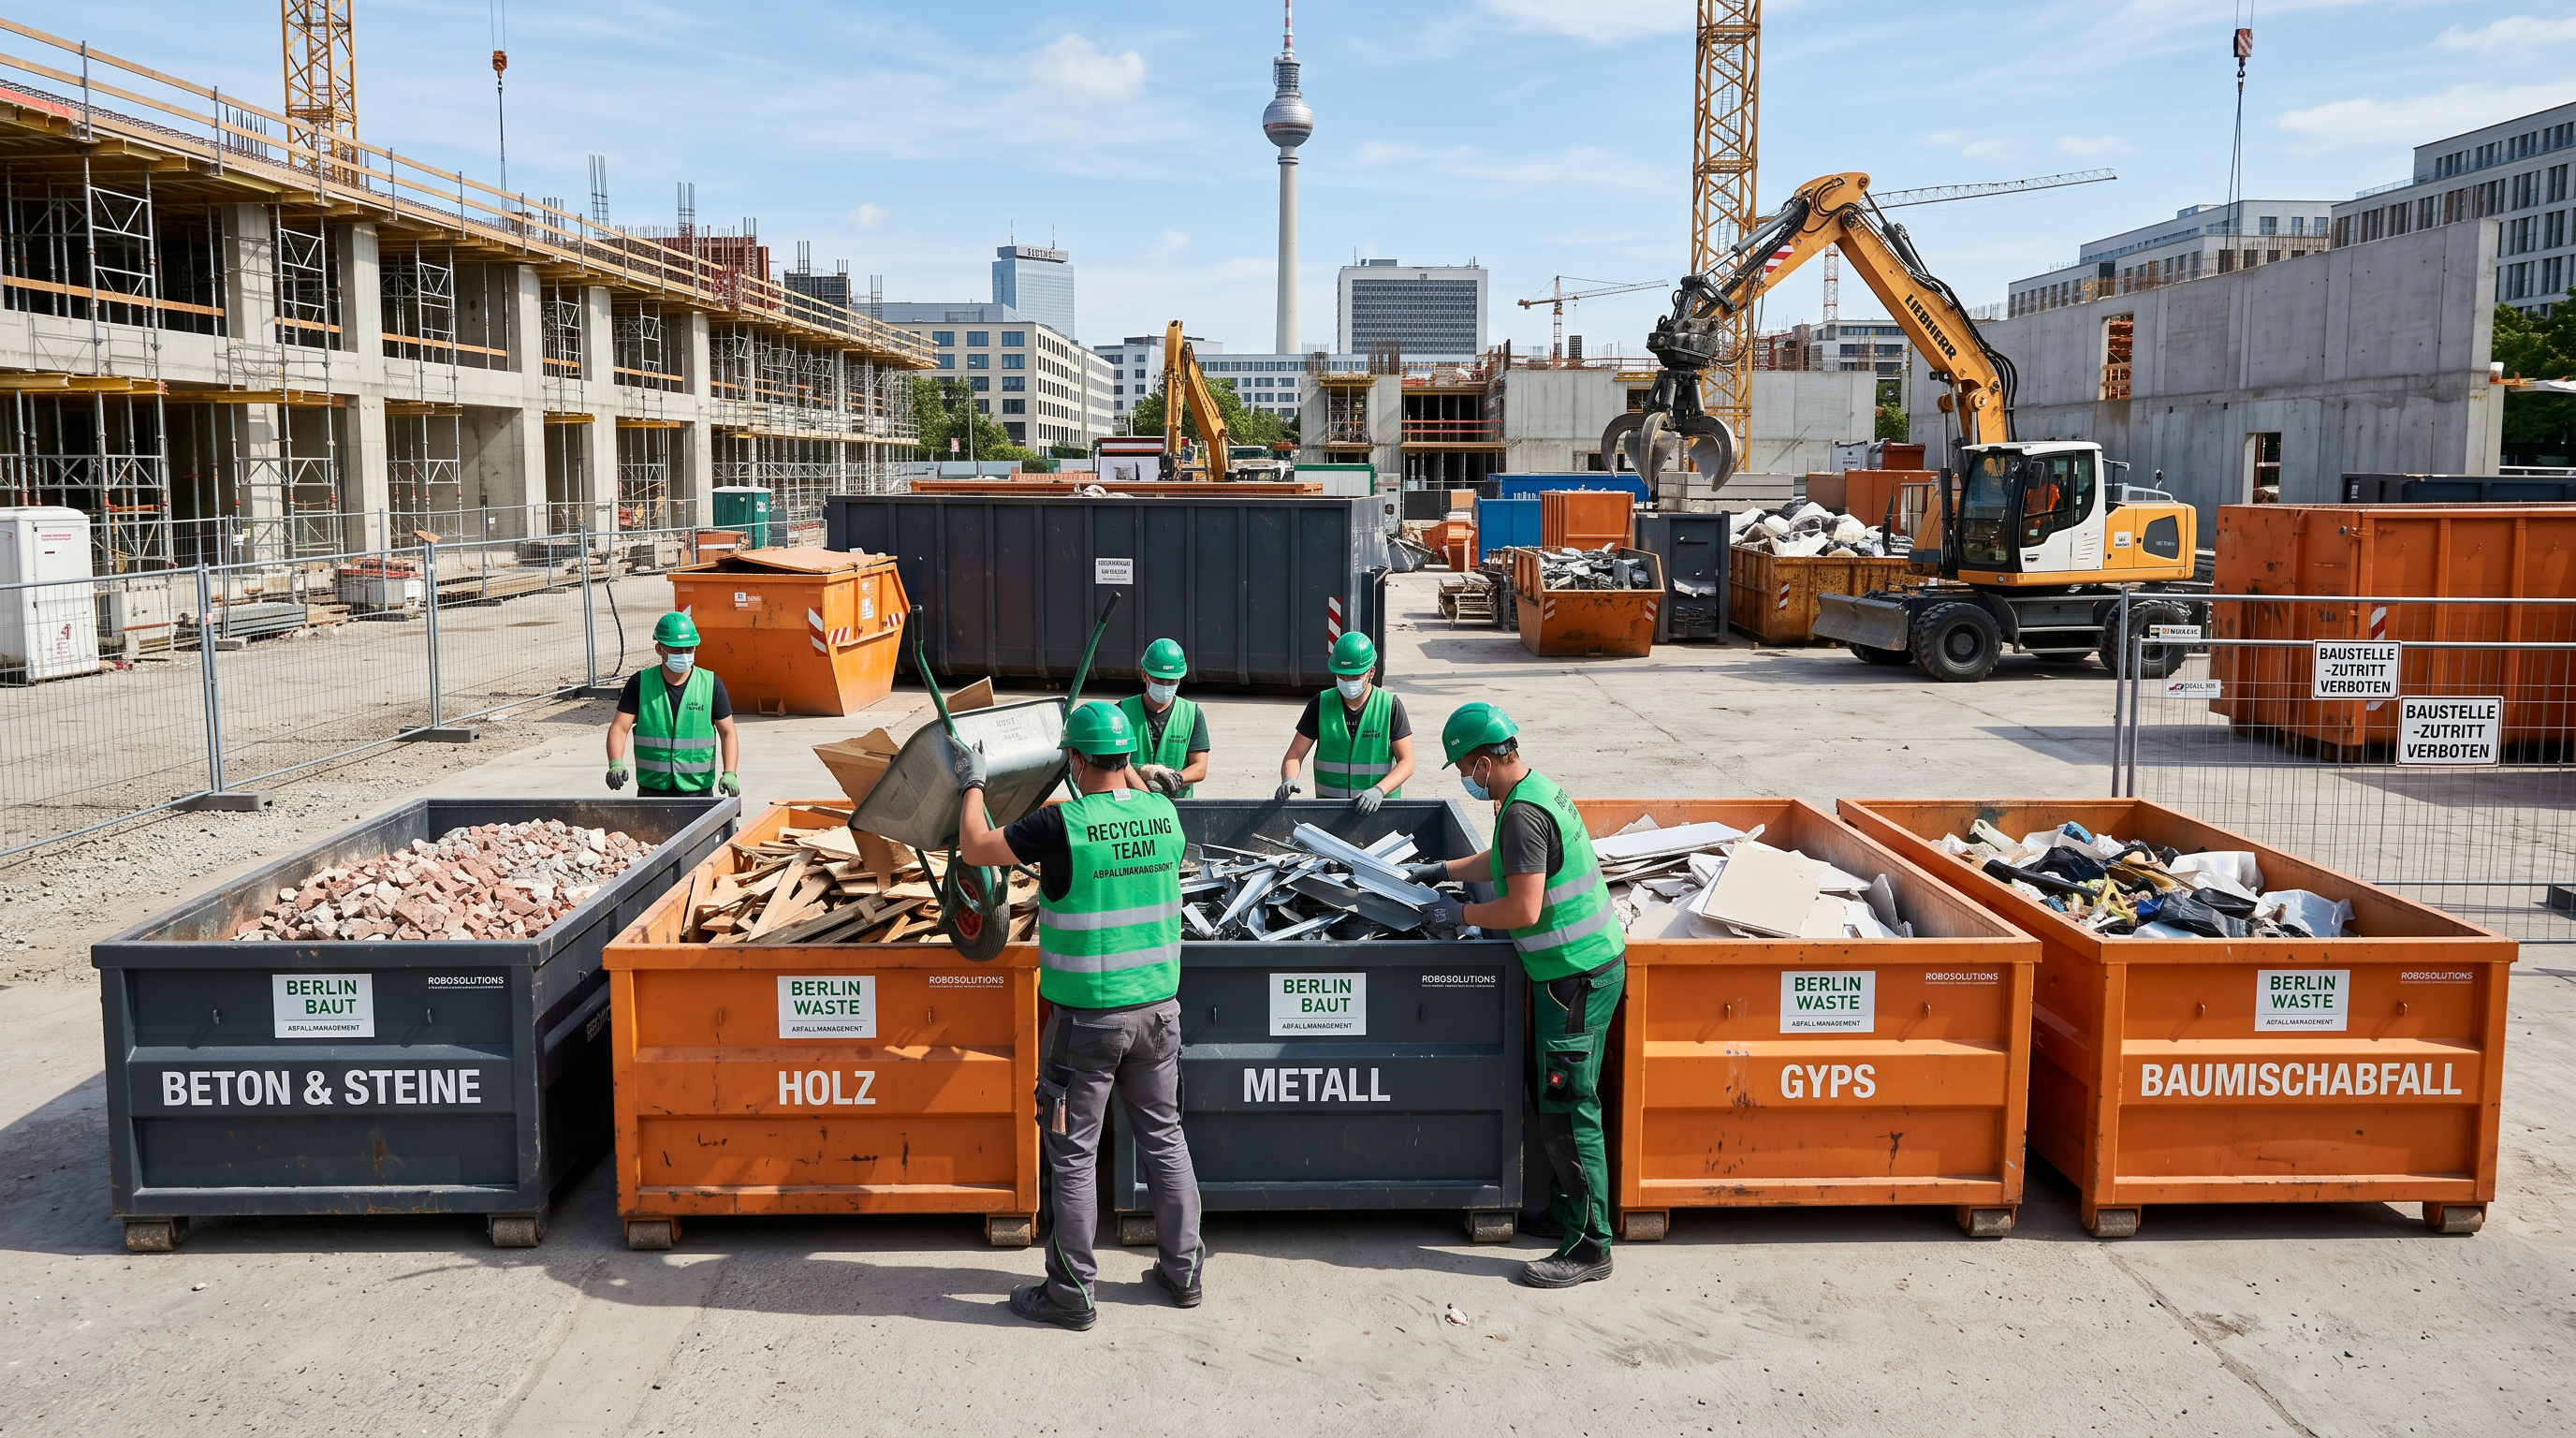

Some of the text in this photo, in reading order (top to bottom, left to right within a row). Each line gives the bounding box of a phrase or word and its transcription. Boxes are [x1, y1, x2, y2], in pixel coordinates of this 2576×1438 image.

[1905, 294, 1956, 361] LIEBHERR
[2320, 648, 2394, 661] BAUSTELLE
[2325, 664, 2386, 676] -ZUTRITT
[2320, 681, 2391, 693] VERBOTEN
[2406, 704, 2496, 719] BAUSTELLE
[2413, 725, 2486, 739] -ZUTRITT
[2408, 743, 2490, 758] VERBOTEN
[1086, 817, 1172, 843] RECYCLING
[1112, 839, 1155, 859] TEAM
[286, 979, 358, 994] BERLIN
[429, 976, 504, 985] ROBOSOLUTIONS
[1283, 979, 1352, 994] BERLIN
[1794, 976, 1861, 991] BERLIN
[2271, 976, 2336, 990] BERLIN
[792, 981, 861, 996] BERLIN
[305, 999, 356, 1014] BAUT
[794, 1000, 859, 1015] WASTE
[1301, 998, 1352, 1013] BAUT
[1796, 995, 1860, 1009] WASTE
[2271, 994, 2334, 1008] WASTE
[1243, 1067, 1391, 1102] METALL
[1780, 1064, 1876, 1099] GYPS
[2142, 1062, 2462, 1097] BAUMISCHABFALL
[163, 1069, 481, 1107] BETON & STEINE
[779, 1070, 876, 1106] HOLZ
